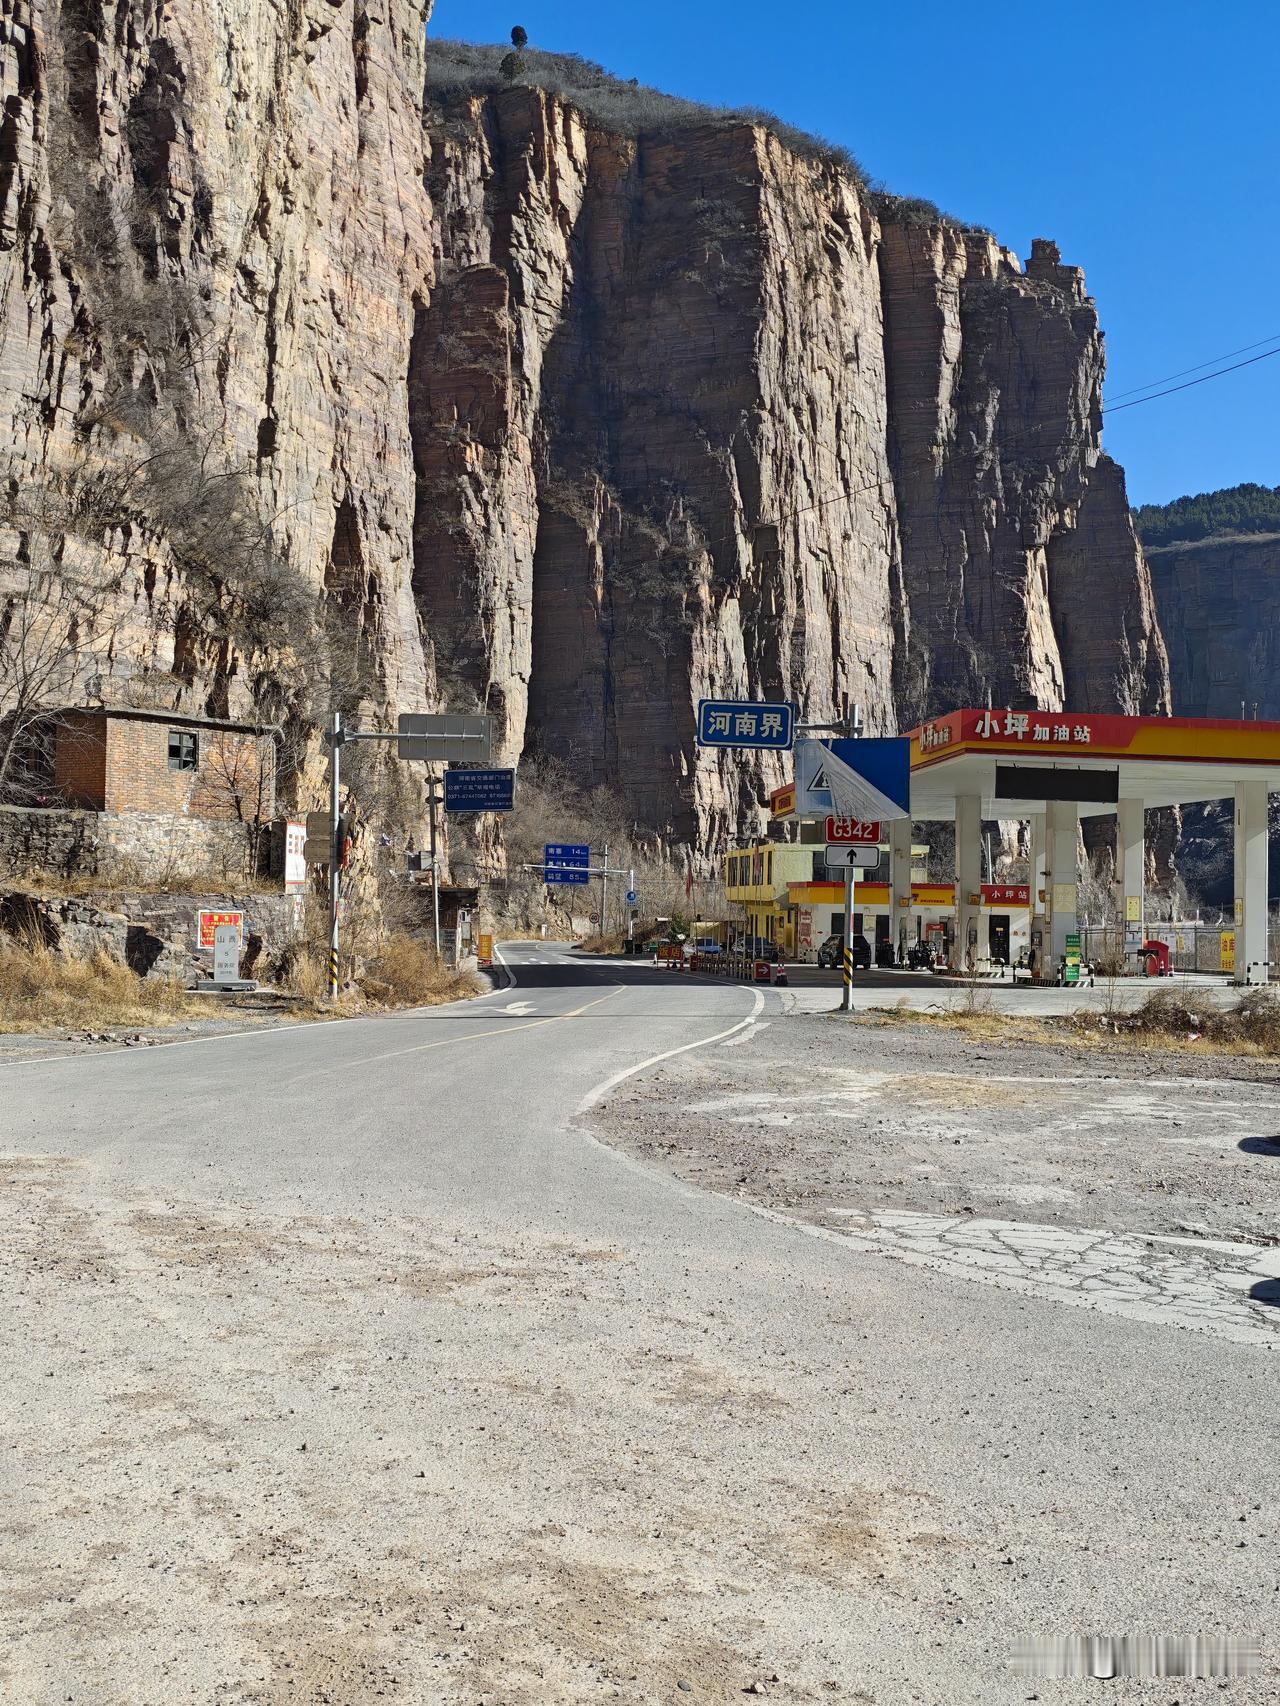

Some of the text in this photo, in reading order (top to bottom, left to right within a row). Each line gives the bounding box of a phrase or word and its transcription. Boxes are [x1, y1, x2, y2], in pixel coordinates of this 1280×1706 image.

[708, 711, 783, 738] 河南界
[833, 822, 873, 838] G342
